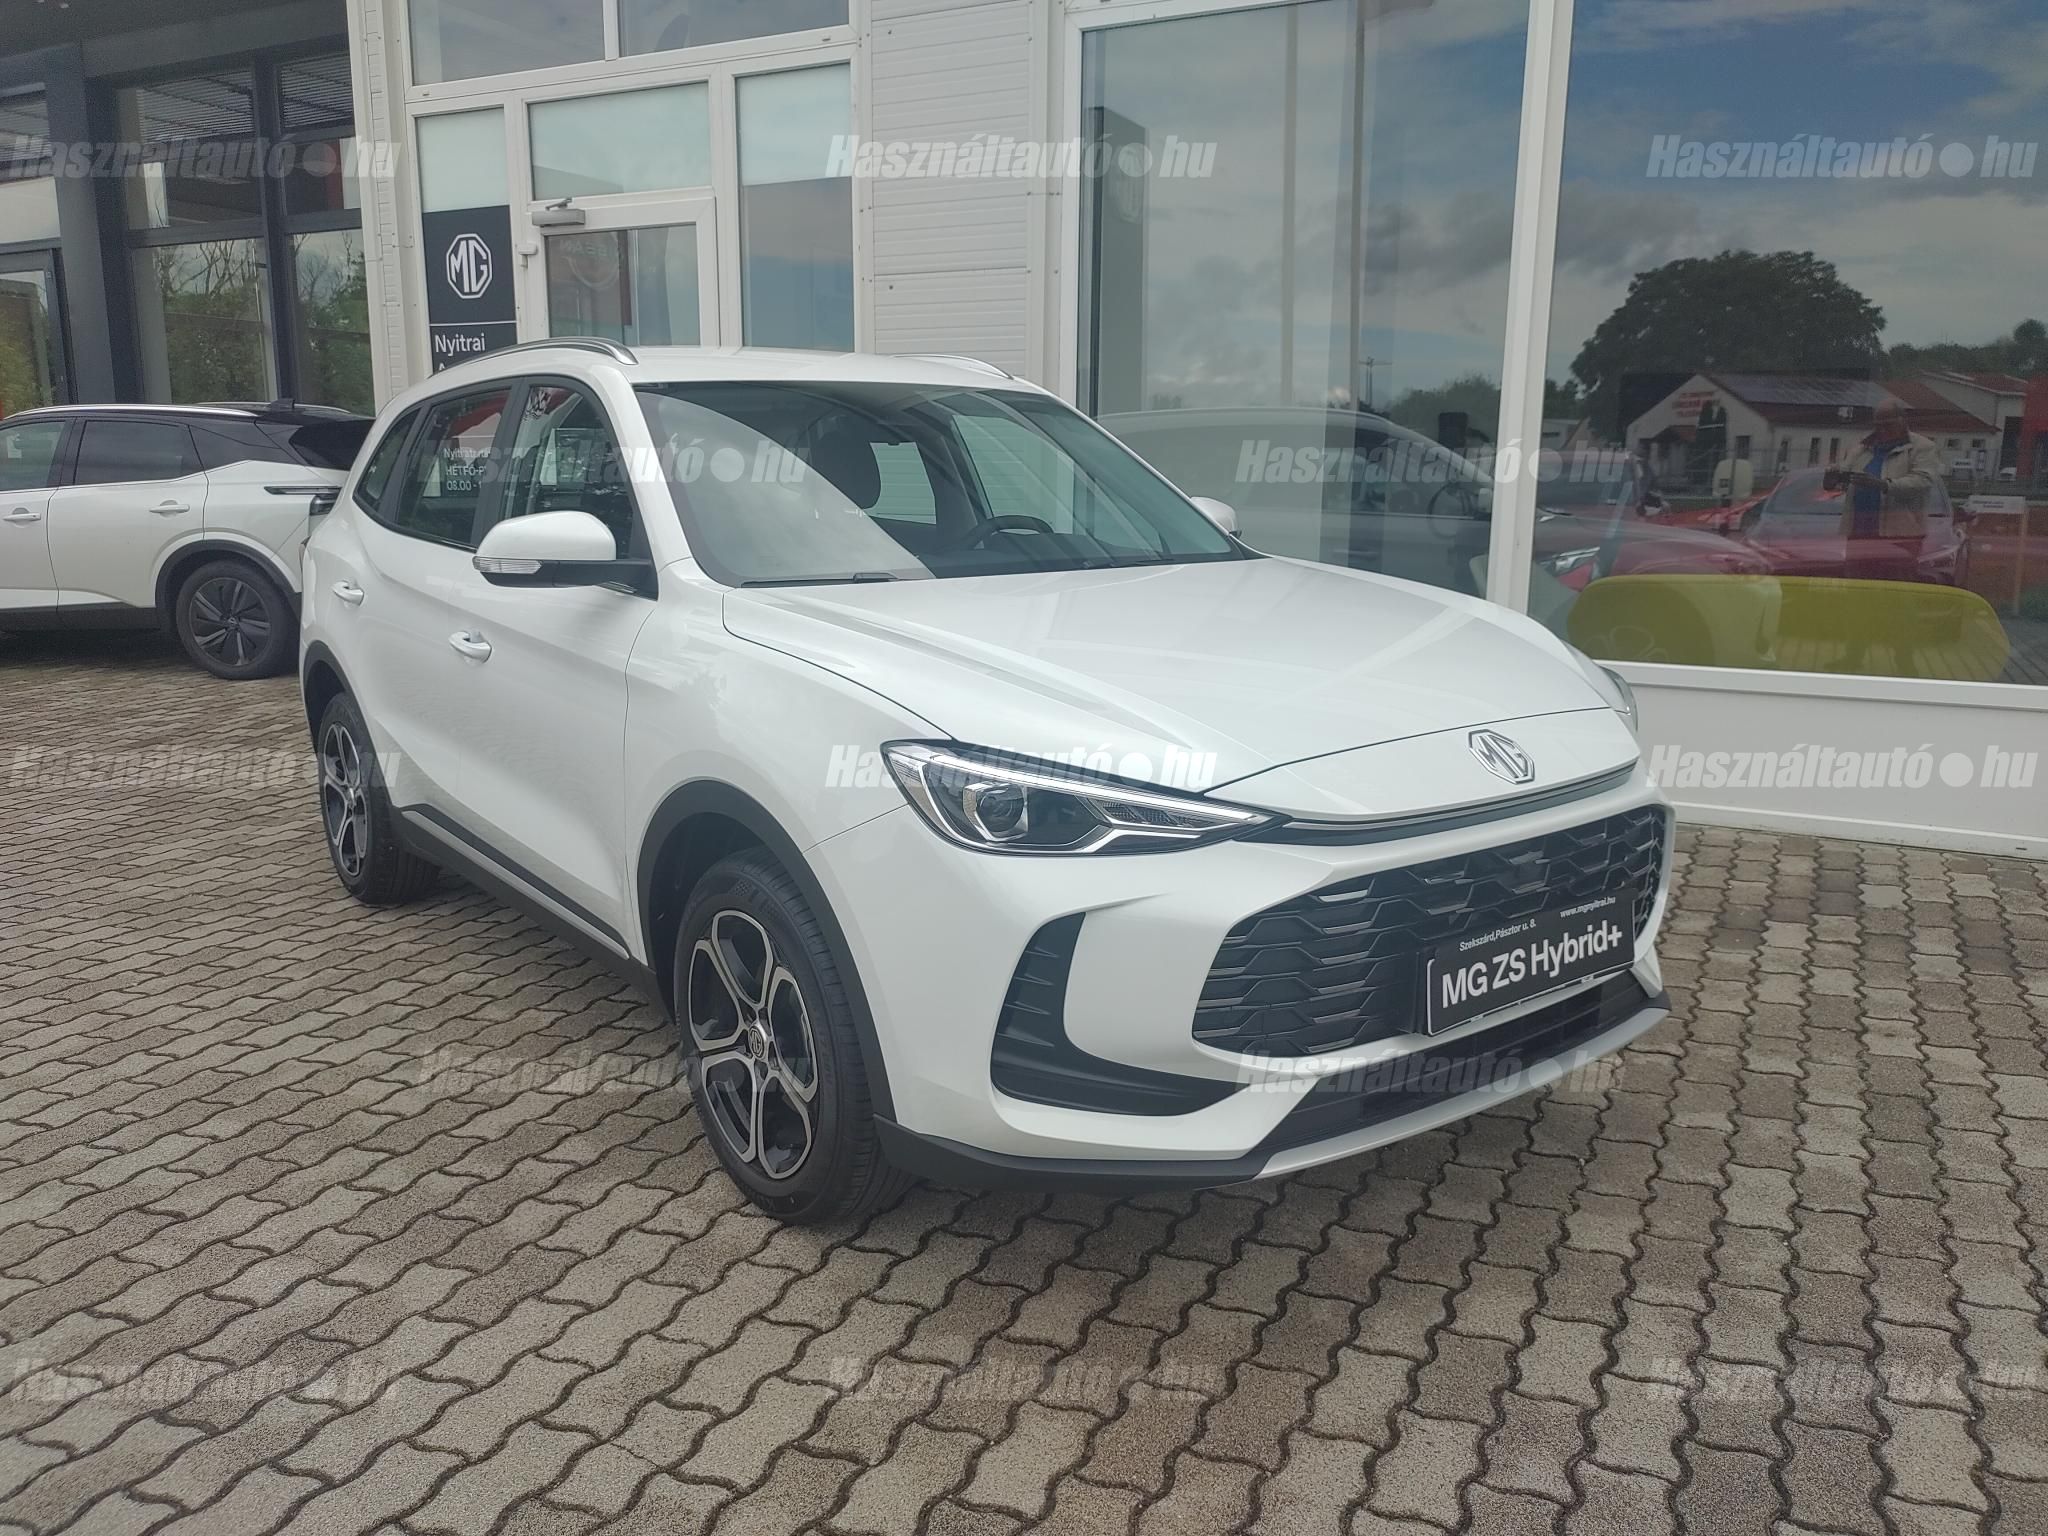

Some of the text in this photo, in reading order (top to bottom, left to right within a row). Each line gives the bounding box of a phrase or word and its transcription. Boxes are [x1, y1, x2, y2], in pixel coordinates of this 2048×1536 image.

[450, 239, 488, 293] MG
[435, 333, 485, 356] Nyitrai
[1475, 733, 1529, 779] MG
[1442, 919, 1622, 1008] MG ZS Hybrid+
